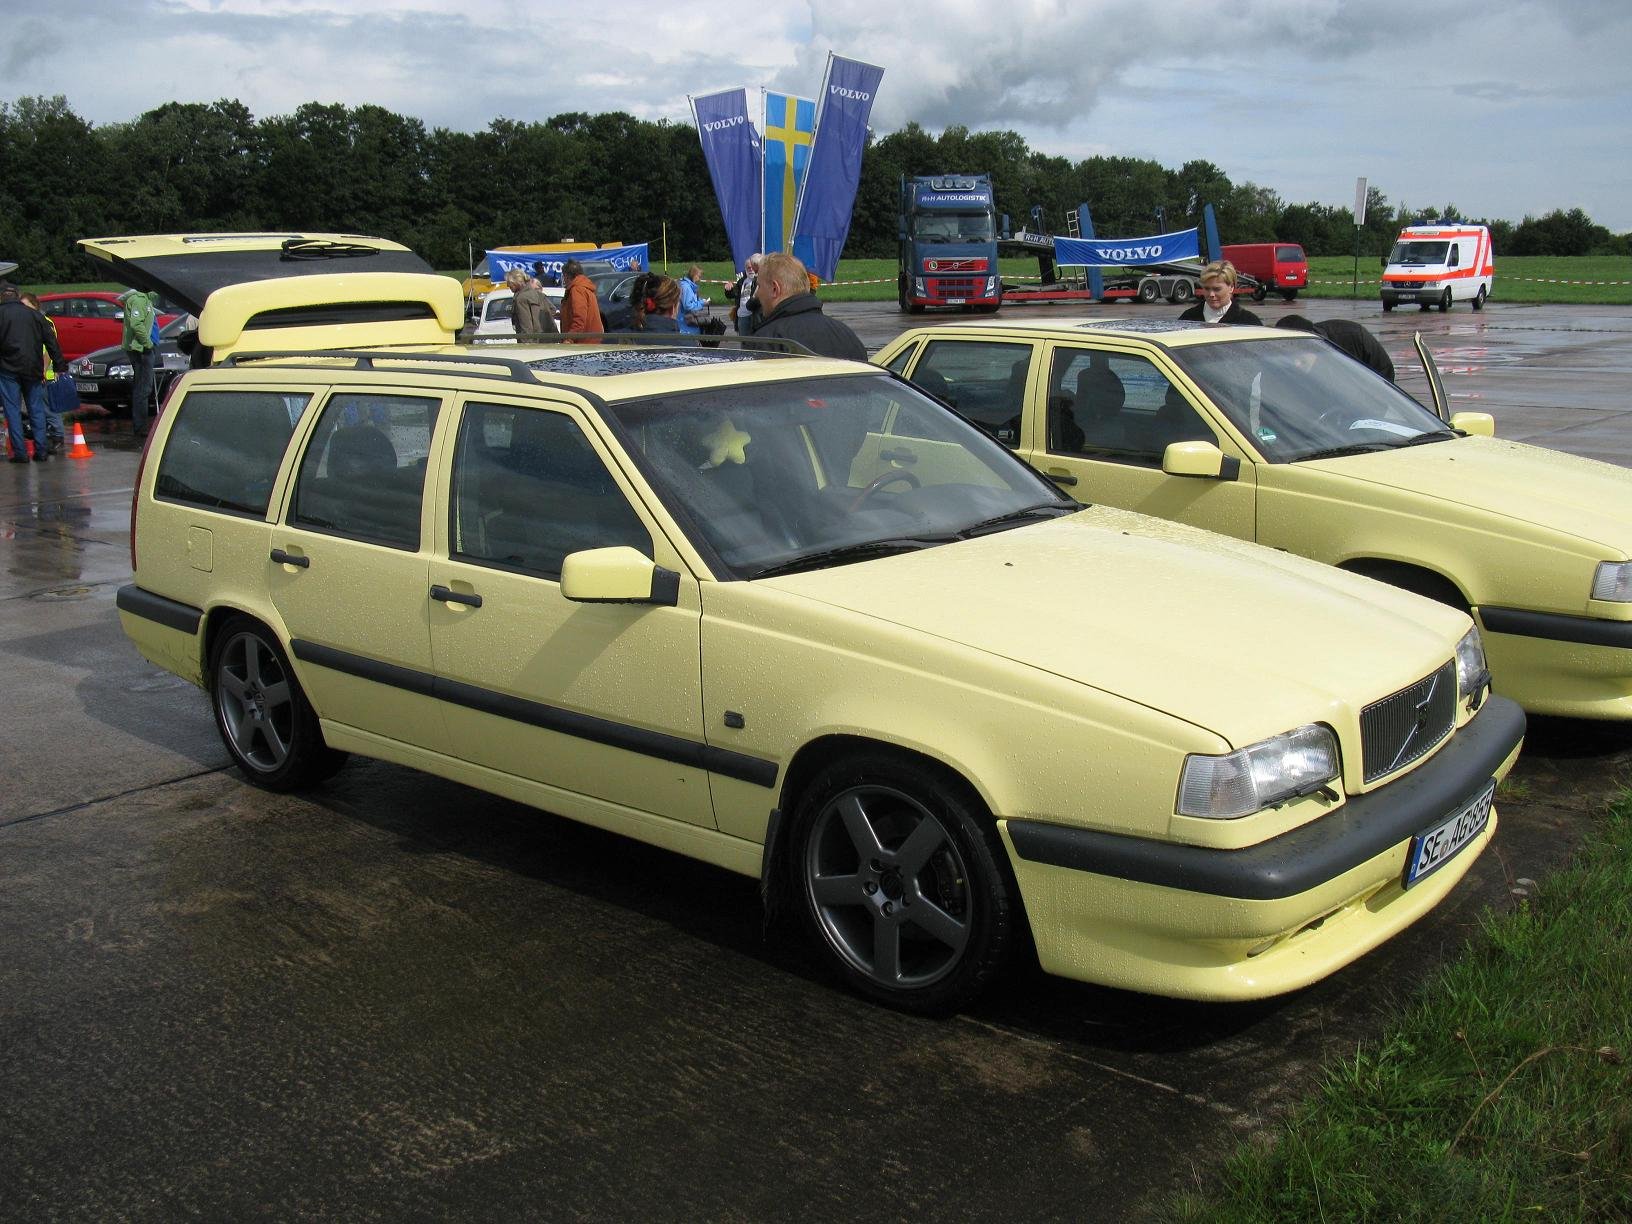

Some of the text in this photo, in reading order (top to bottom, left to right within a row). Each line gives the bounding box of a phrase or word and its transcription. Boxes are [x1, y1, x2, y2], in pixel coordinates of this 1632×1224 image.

[831, 85, 869, 101] VOLVO
[703, 115, 743, 132] VOLVO
[936, 194, 986, 202] AUTOLOGISTIK
[1095, 245, 1162, 260] VOLVO
[1420, 829, 1445, 870] SE
